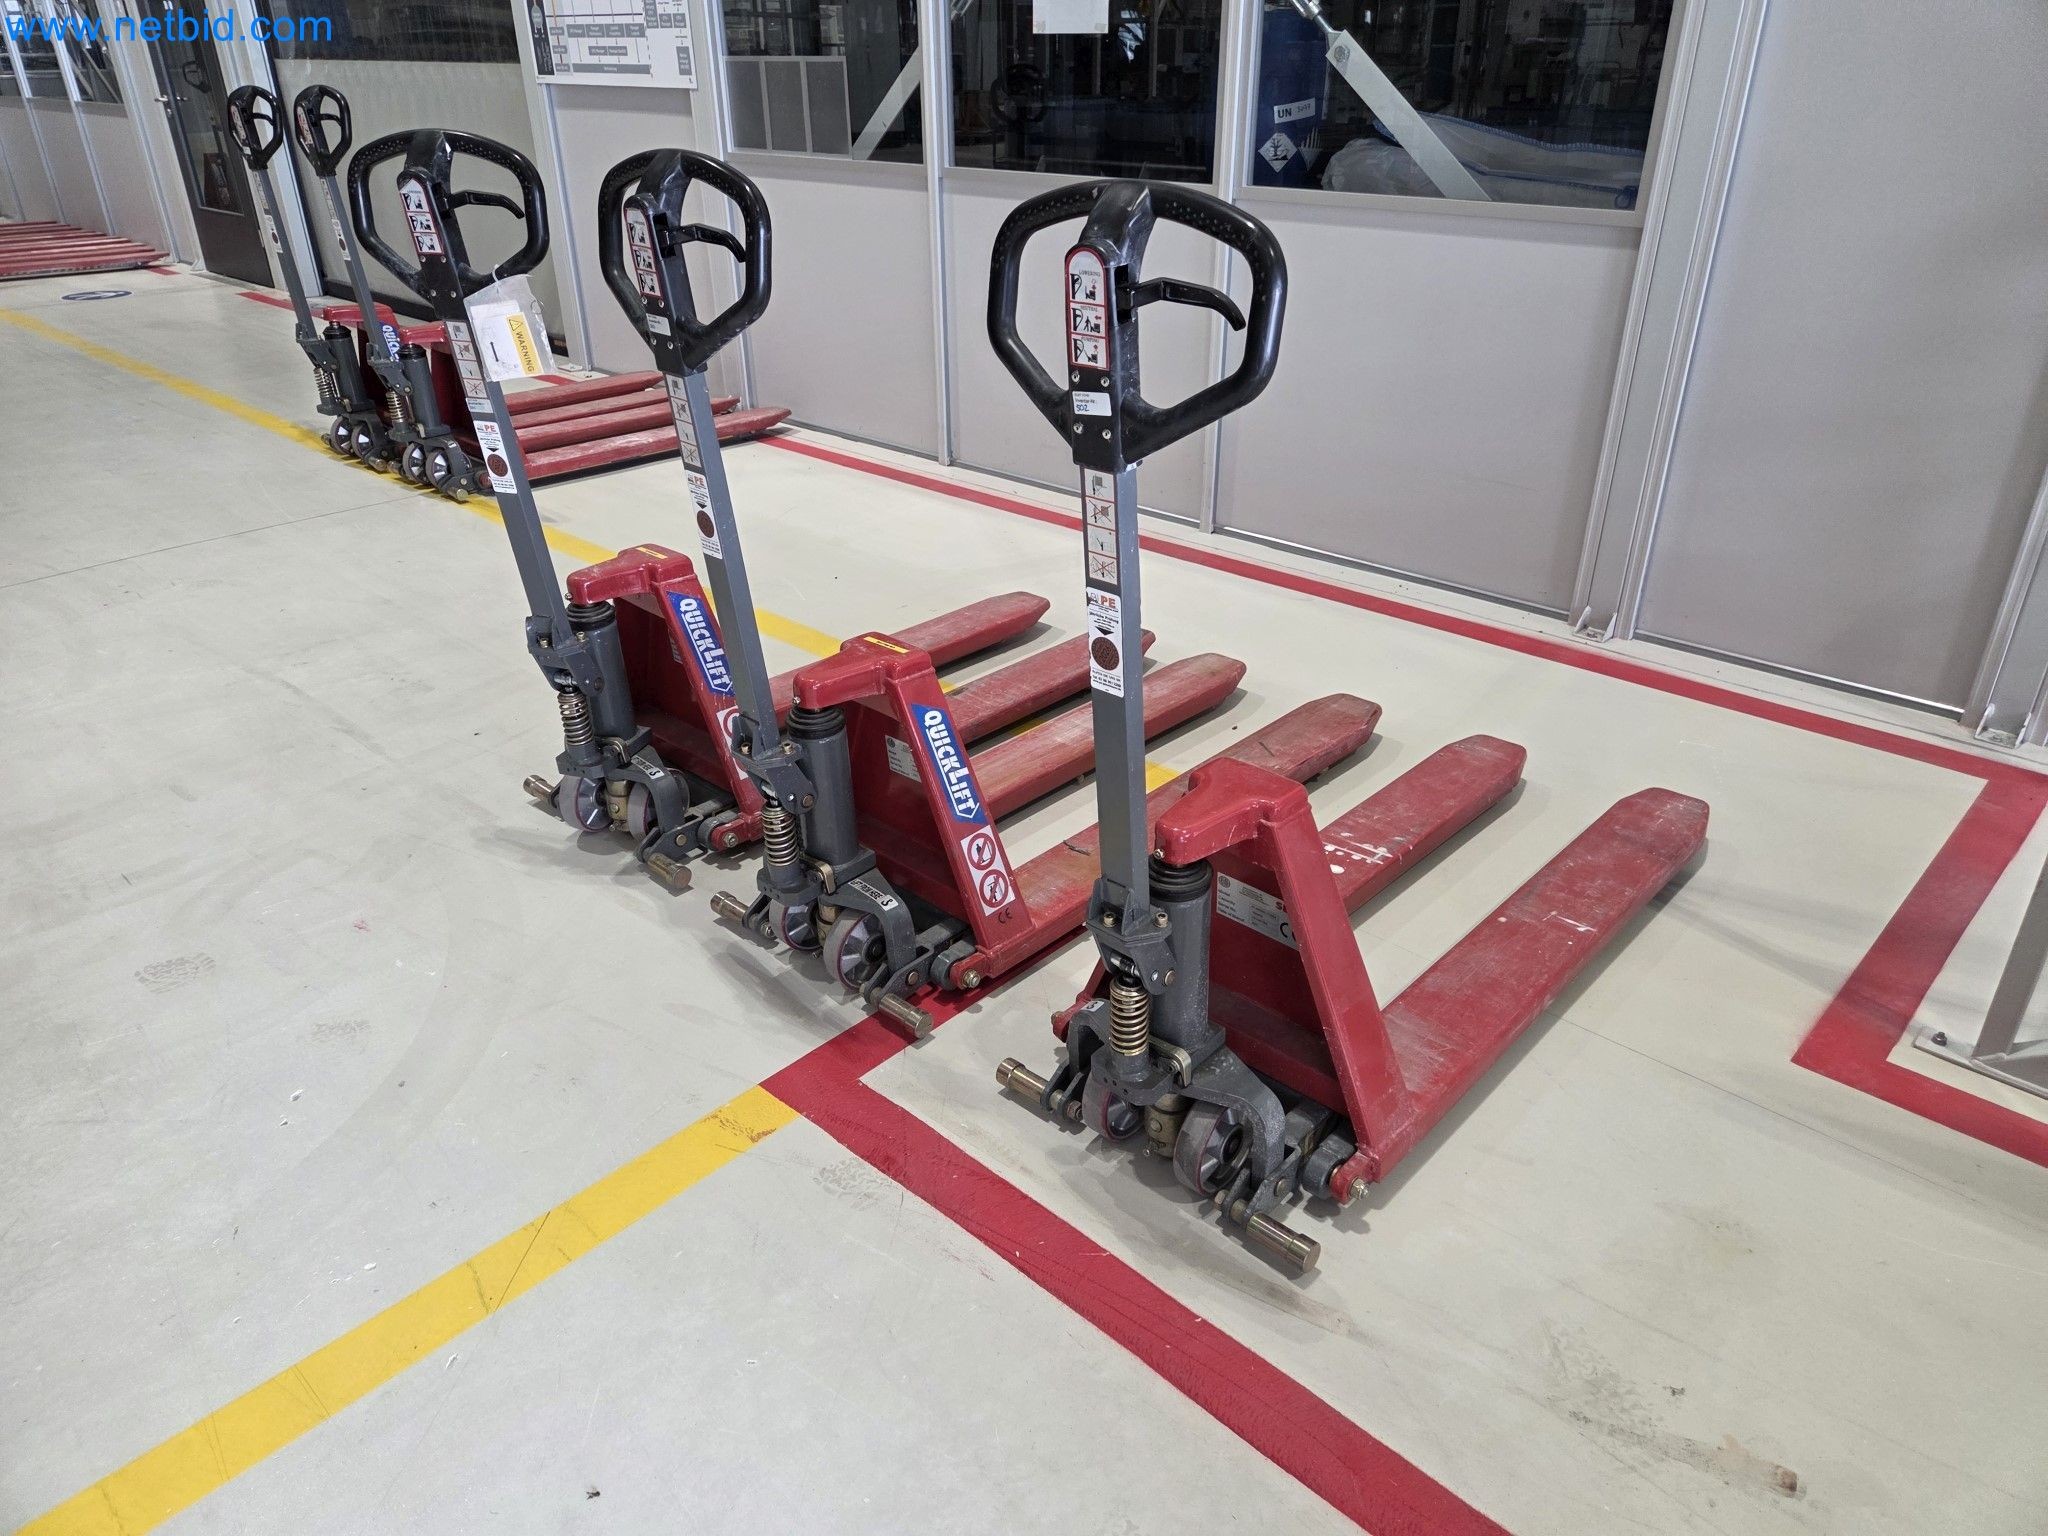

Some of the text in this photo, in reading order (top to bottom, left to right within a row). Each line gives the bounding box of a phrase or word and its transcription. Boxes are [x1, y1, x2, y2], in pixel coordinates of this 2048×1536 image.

[1278, 107, 1292, 118] UN
[516, 331, 535, 372] WARNING
[1100, 595, 1116, 609] PE
